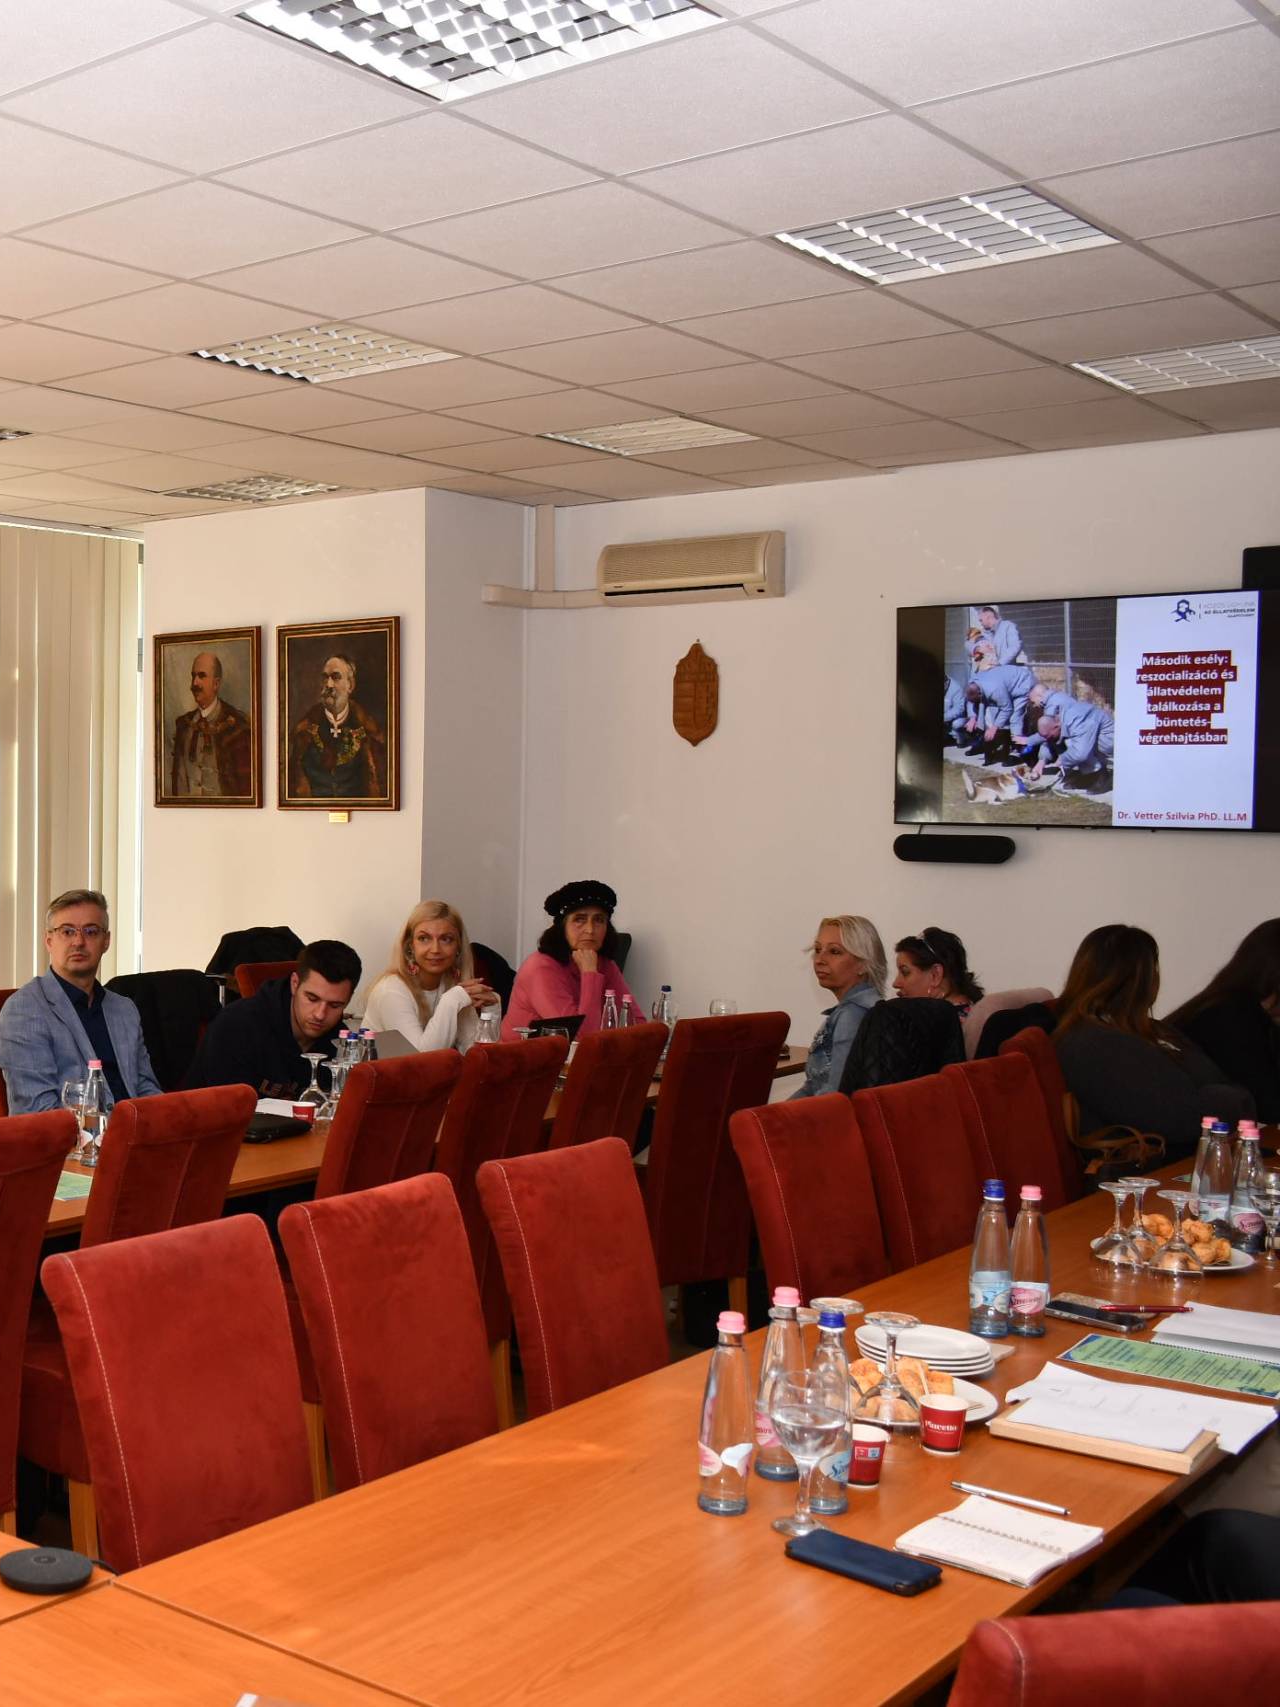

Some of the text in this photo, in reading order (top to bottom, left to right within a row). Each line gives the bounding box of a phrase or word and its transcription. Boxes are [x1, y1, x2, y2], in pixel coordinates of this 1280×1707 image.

[1142, 653, 1229, 666] Második esély:
[1136, 668, 1234, 682] reszocializáció és
[1147, 685, 1222, 697] állatvédelem
[1147, 701, 1221, 712] találkozása a
[1156, 716, 1213, 728] büntetés-
[1139, 732, 1228, 744] végrehajtásban
[1117, 811, 1247, 821] Dr. Vetter Szilvia PhD. LL.M
